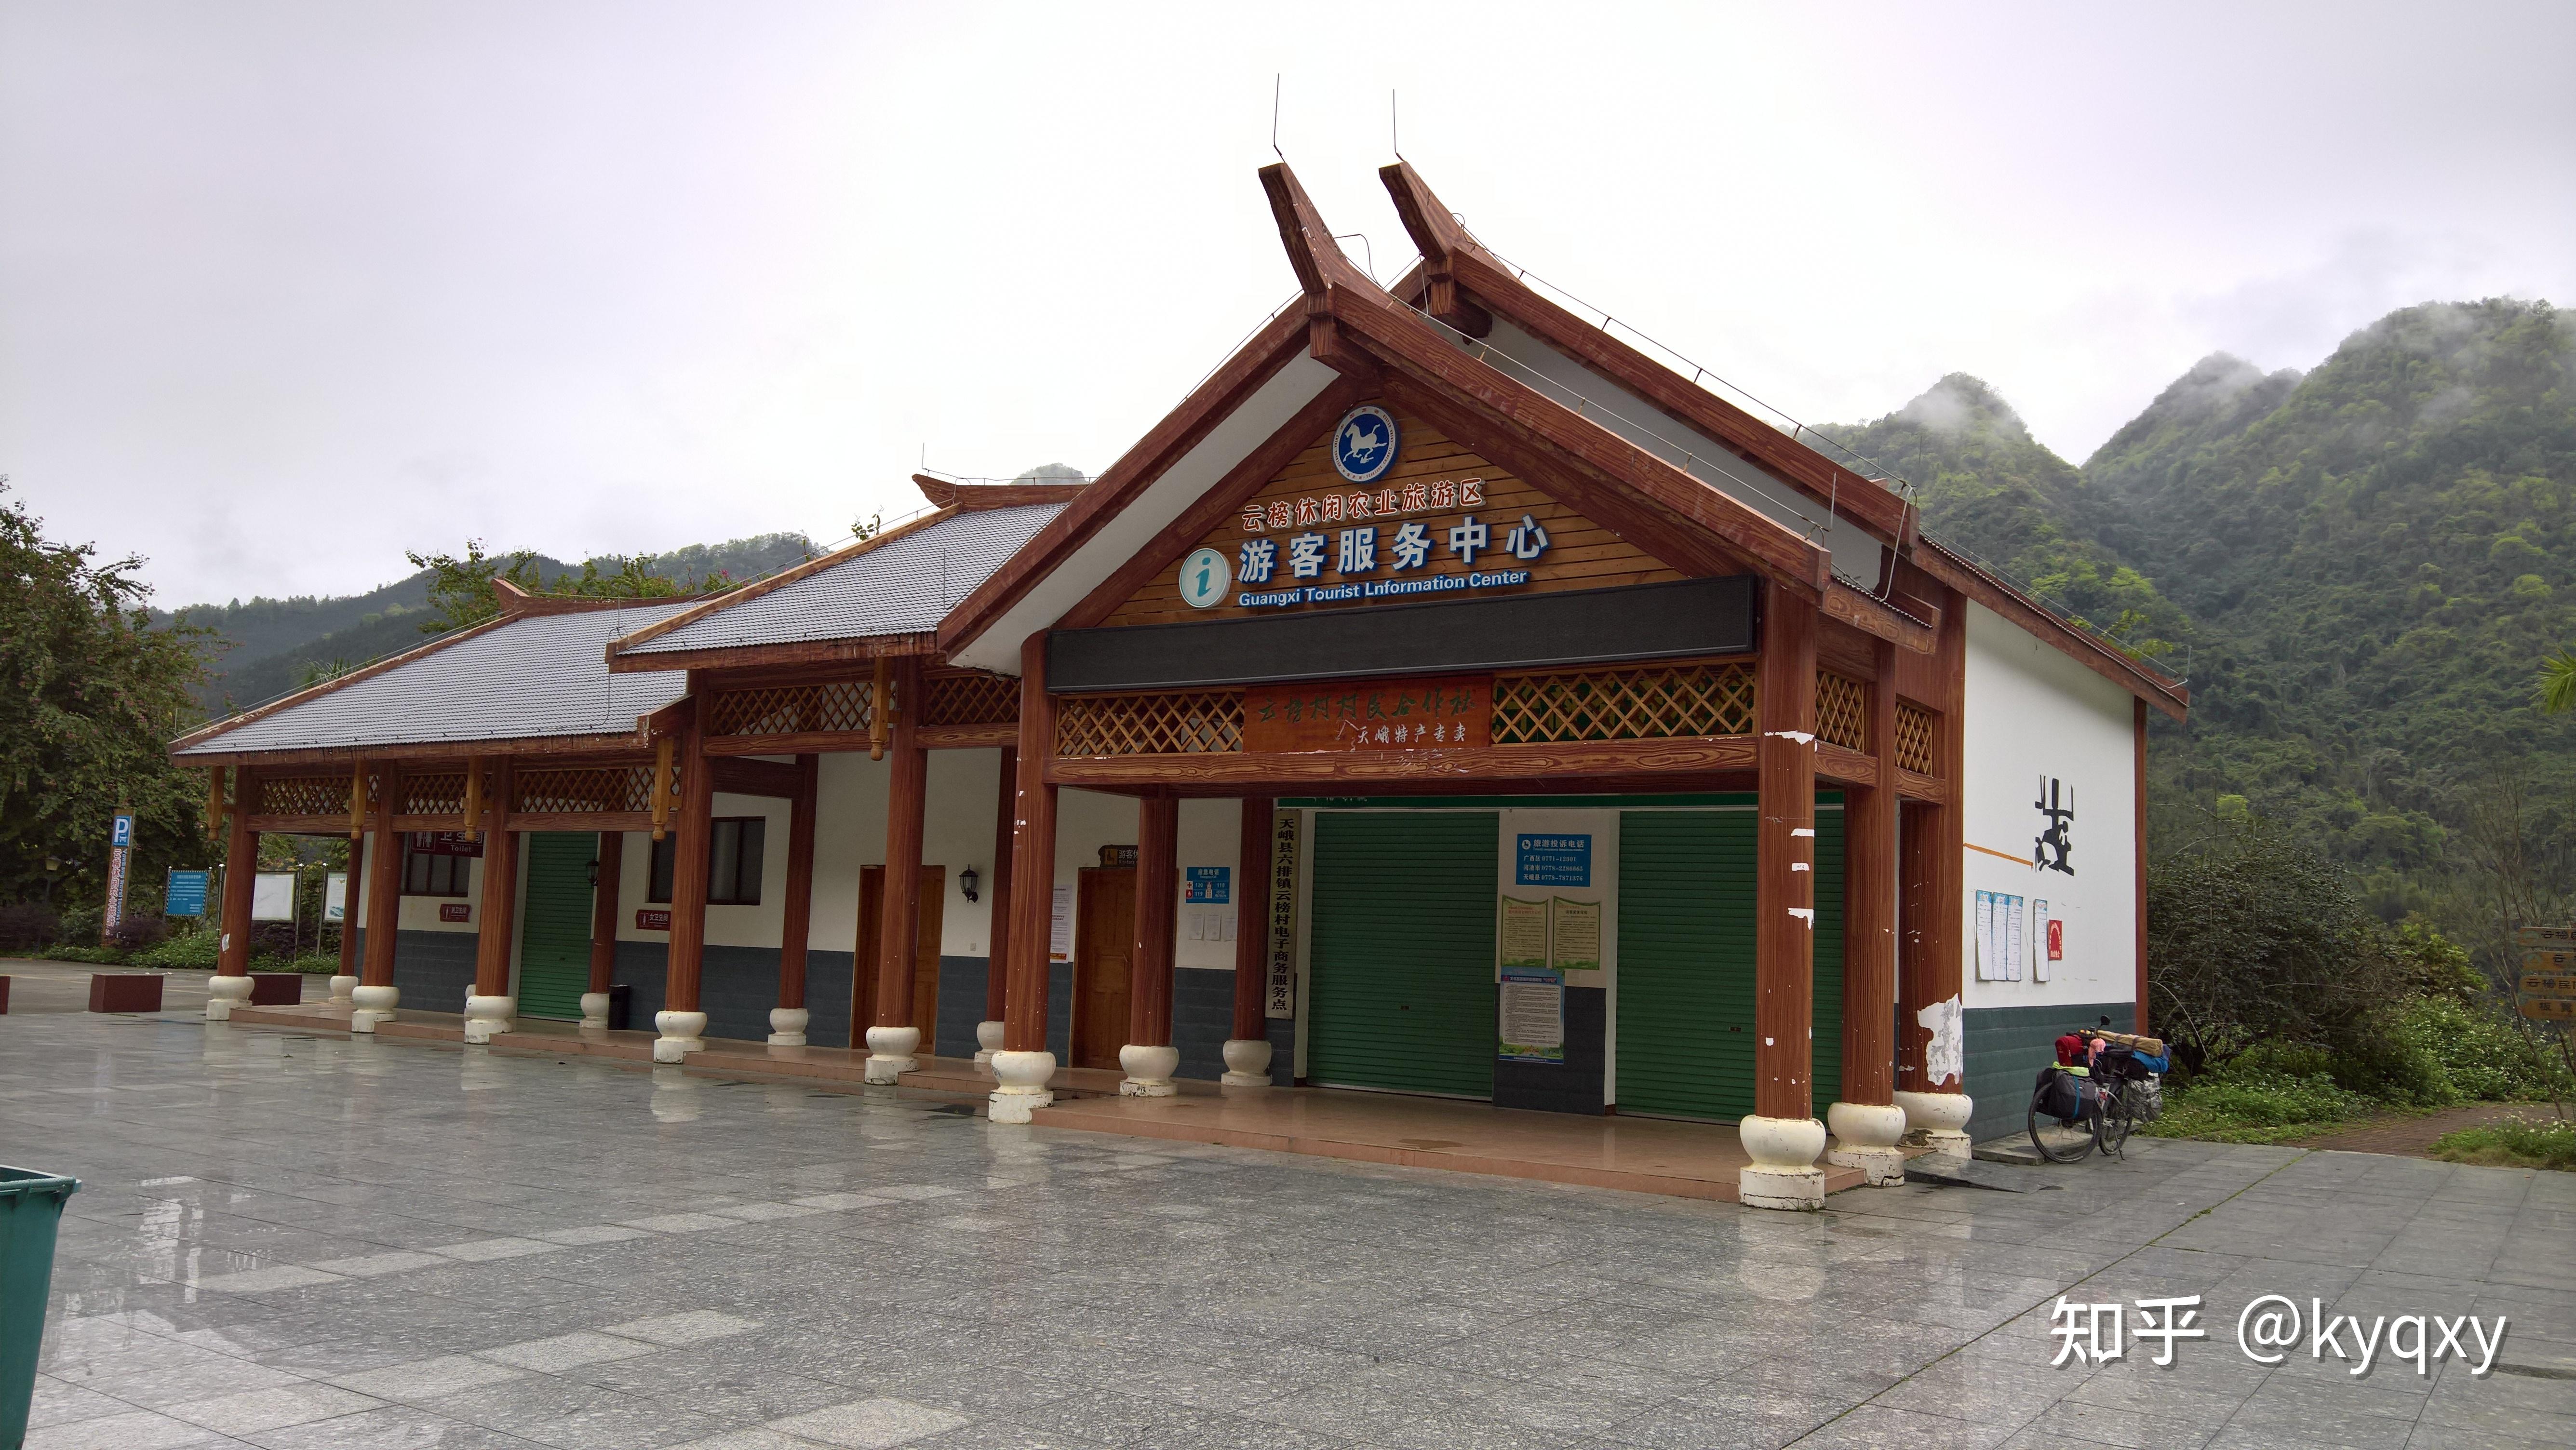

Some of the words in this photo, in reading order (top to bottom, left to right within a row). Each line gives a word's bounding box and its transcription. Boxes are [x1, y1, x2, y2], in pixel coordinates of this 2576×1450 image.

[1242, 478, 1482, 532] 云榜休闲农业旅游区
[1237, 514, 1548, 584] 游客服务中心
[1239, 591, 1301, 608] Guangxi
[1305, 586, 1360, 602] Tourist
[1365, 576, 1466, 596] Lnformation
[1469, 570, 1528, 588] Center
[1259, 687, 1478, 723] 云榜村村民合作社
[1356, 721, 1466, 744] 天峨特产专卖
[114, 819, 128, 843] P
[1533, 839, 1585, 848] 旅游投诉电话
[649, 913, 668, 922] 女卫生间
[1272, 818, 1294, 1010] 天峨县六排镇云榜村电子商务服务点
